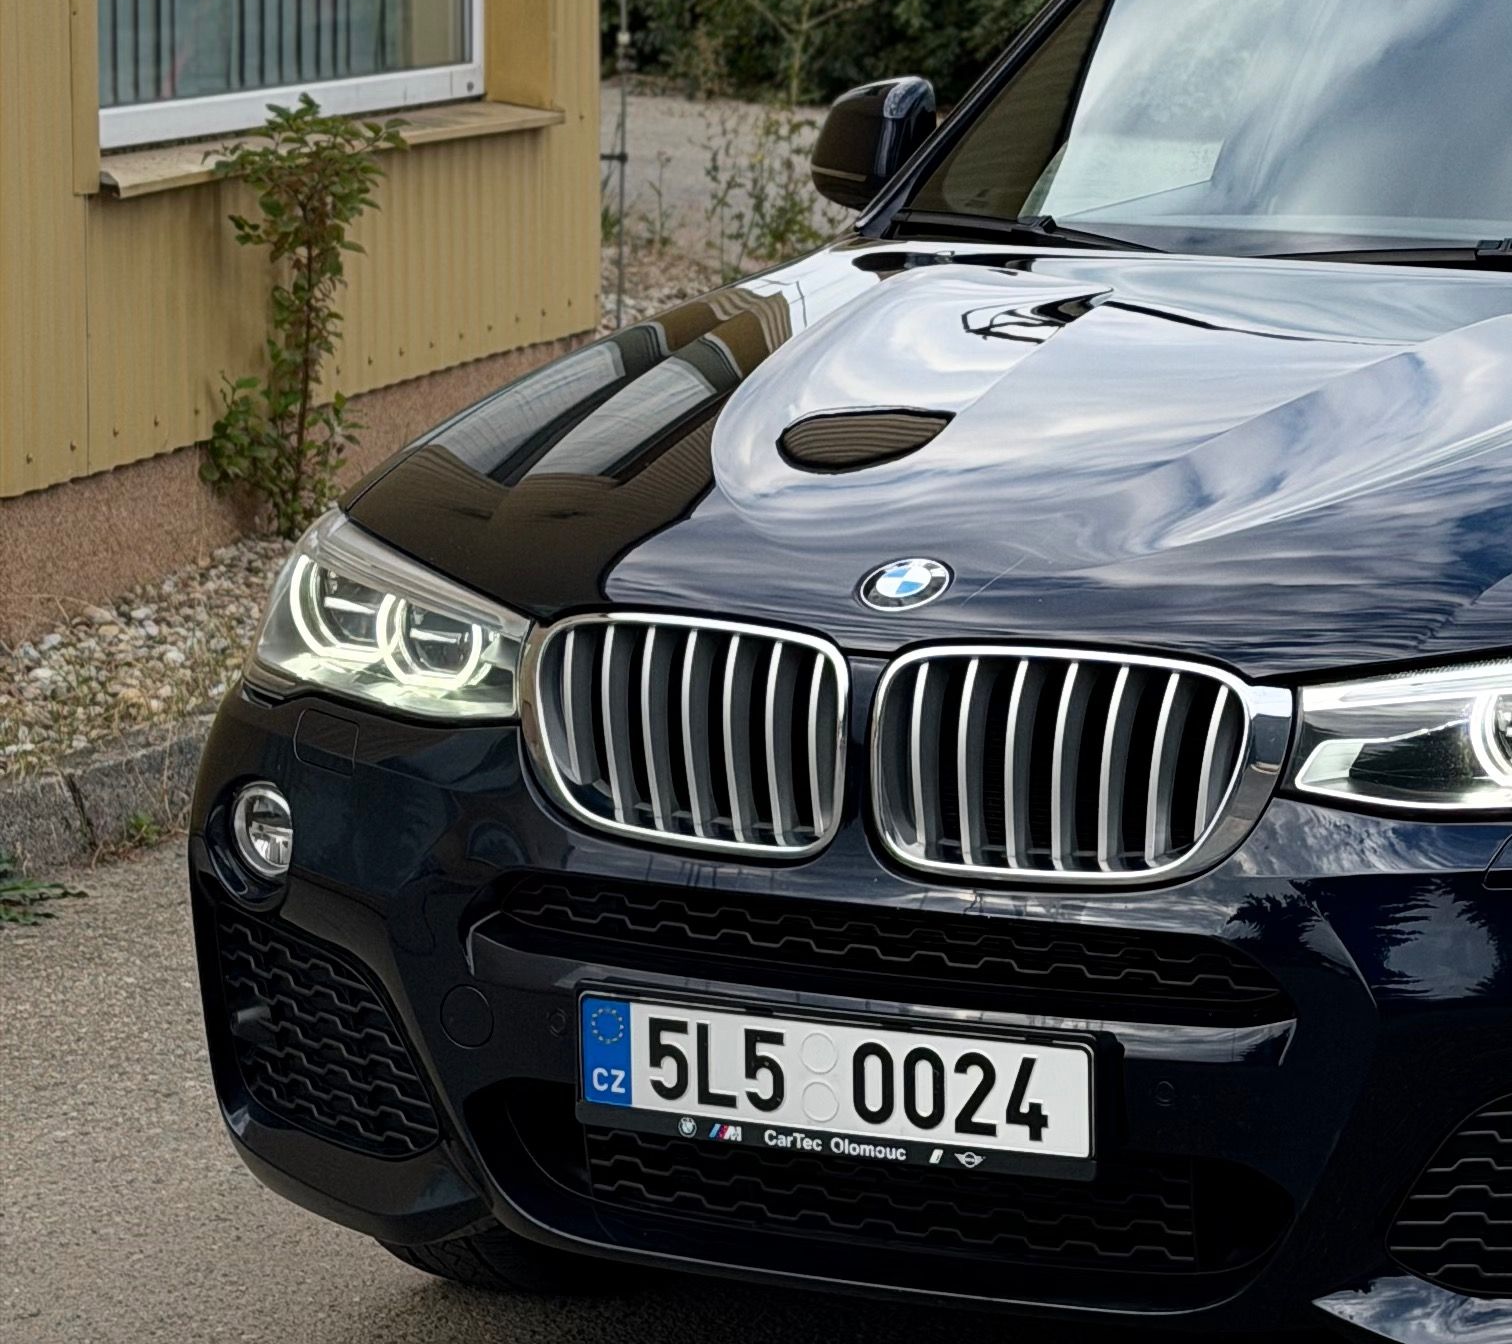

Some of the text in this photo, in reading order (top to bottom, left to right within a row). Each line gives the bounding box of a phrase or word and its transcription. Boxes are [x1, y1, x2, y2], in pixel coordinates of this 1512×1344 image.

[591, 1067, 626, 1094] CZ
[648, 1016, 1049, 1142] 5L5 0024
[763, 1129, 907, 1161] CarTec Olomouc
